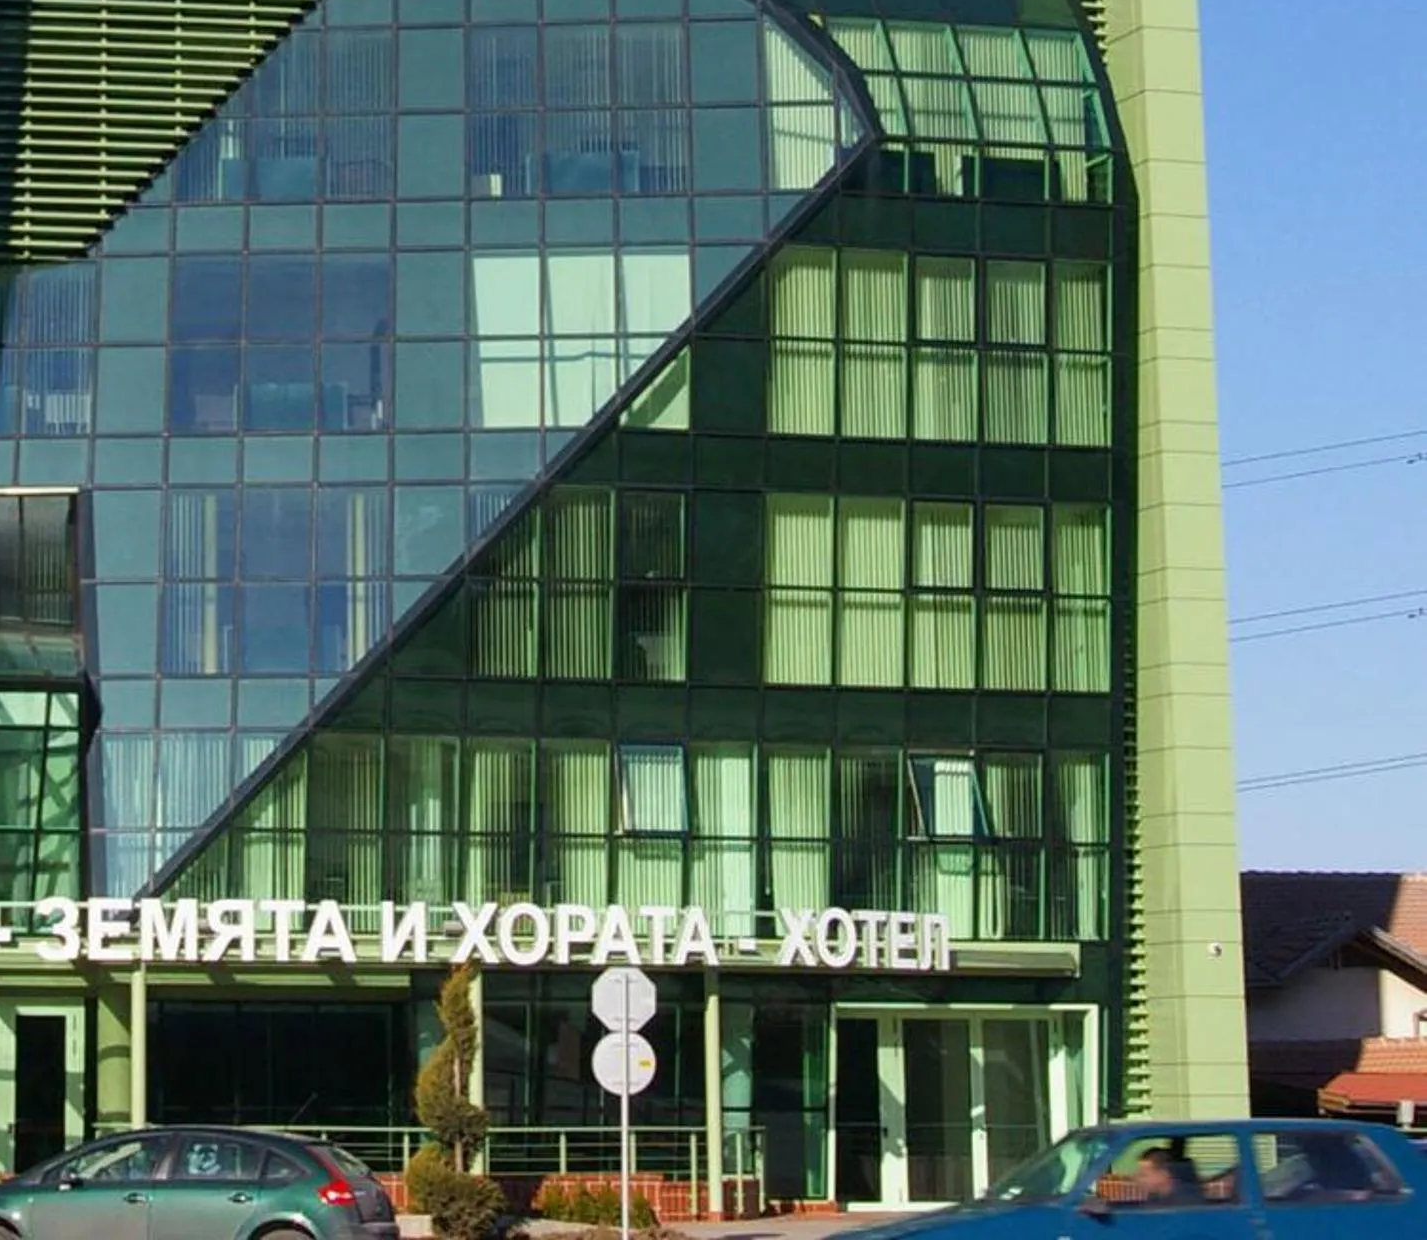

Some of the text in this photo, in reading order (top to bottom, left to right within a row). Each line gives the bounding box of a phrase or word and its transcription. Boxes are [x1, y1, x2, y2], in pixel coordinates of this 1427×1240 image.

[35, 896, 356, 962] ЗЕМЯТА
[381, 900, 427, 963] И
[451, 901, 720, 966] ХОРАТА
[778, 907, 951, 971] ХОТЕЛ
